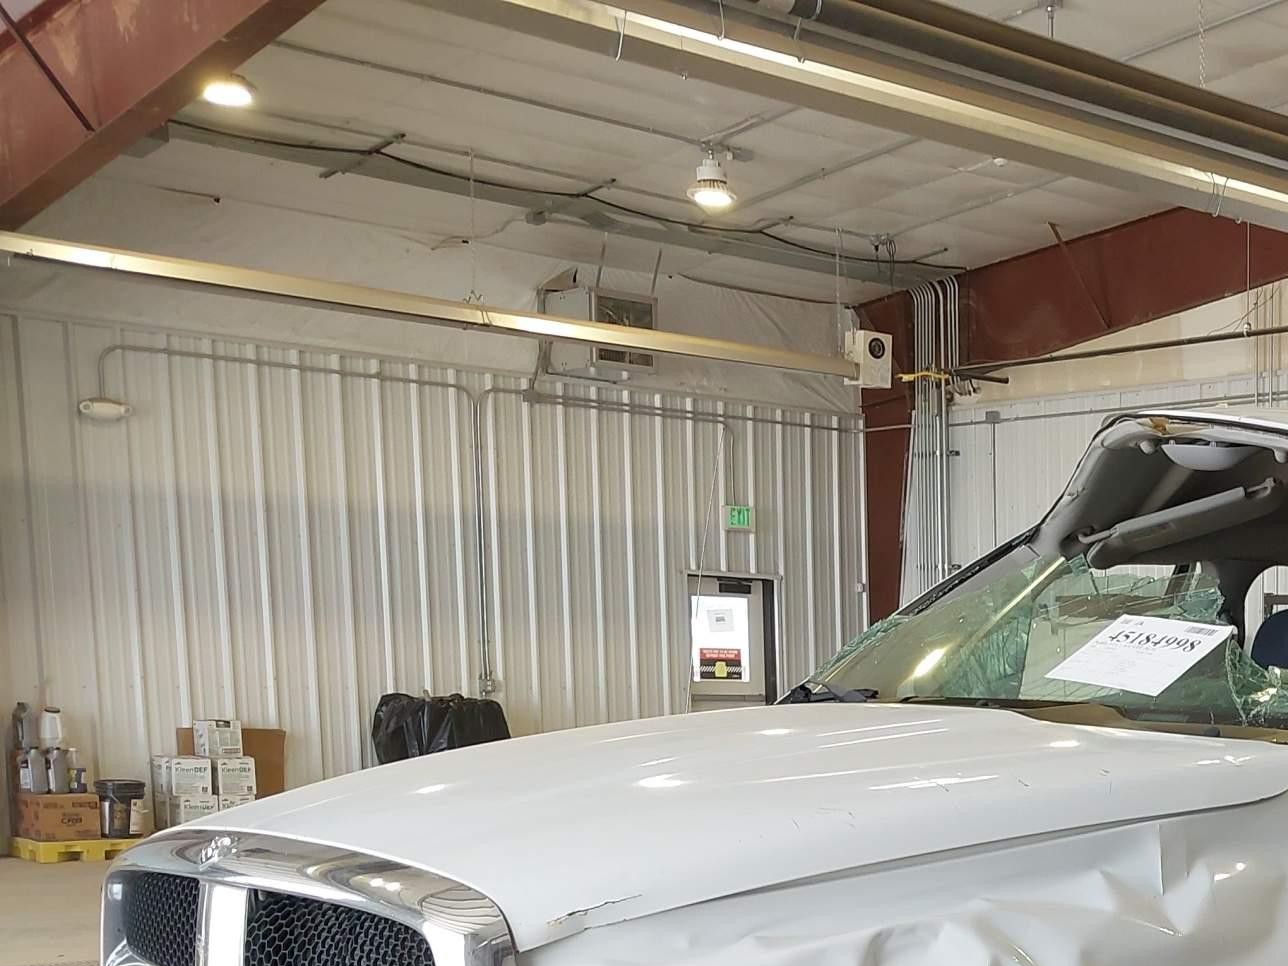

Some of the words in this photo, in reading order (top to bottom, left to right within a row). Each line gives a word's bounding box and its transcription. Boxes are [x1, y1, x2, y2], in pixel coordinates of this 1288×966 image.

[730, 506, 751, 526] EXIT
[1108, 629, 1203, 653] 45184998
[175, 766, 208, 774] KleenDEF
